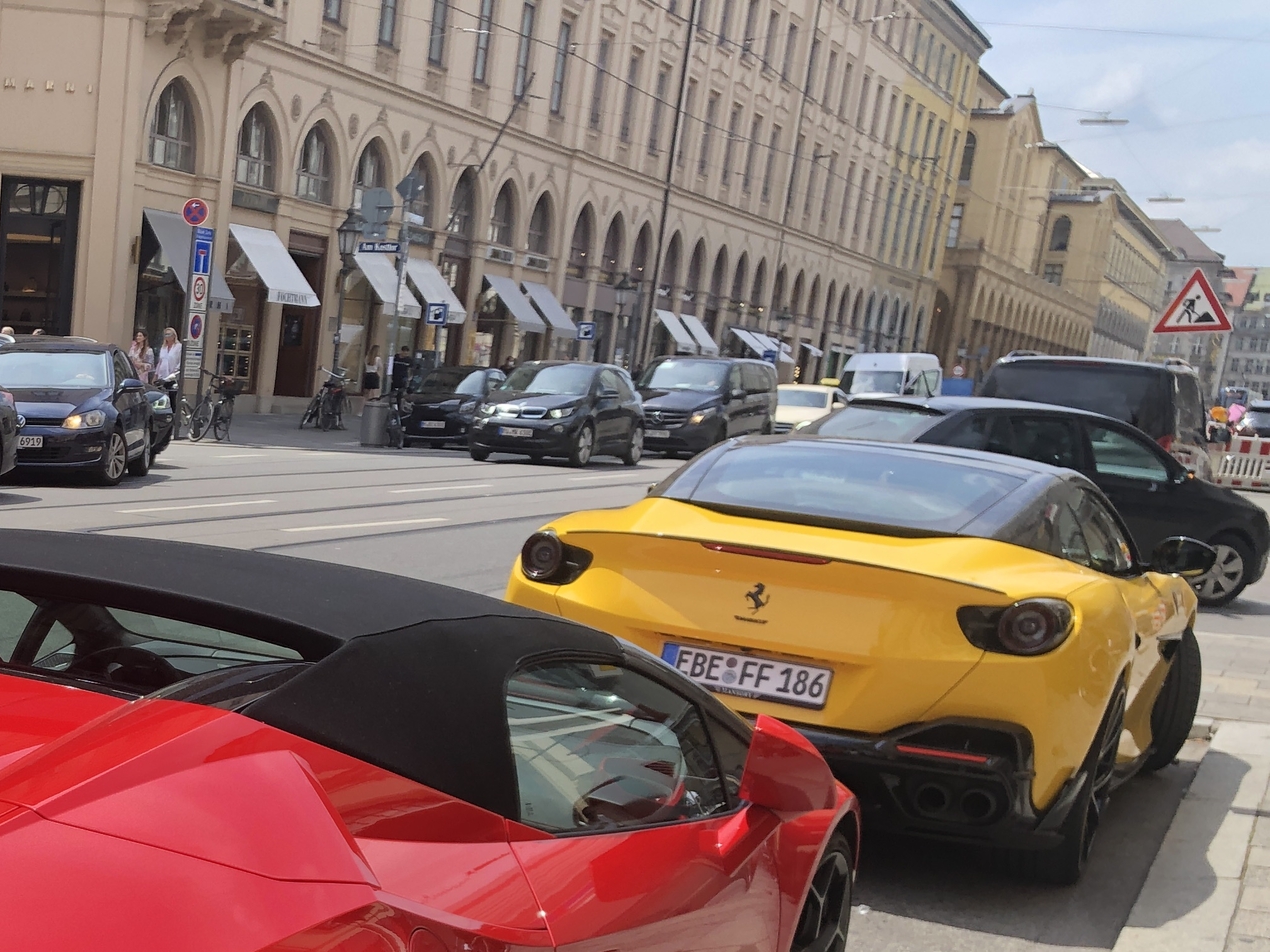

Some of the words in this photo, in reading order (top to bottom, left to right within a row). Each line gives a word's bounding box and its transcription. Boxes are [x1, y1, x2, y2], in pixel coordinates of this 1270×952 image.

[3, 77, 94, 94] MARNI
[196, 283, 203, 295] 30
[19, 437, 42, 447] 6919
[676, 650, 724, 682] EBE
[738, 660, 774, 688] FF
[776, 667, 826, 698] 186
